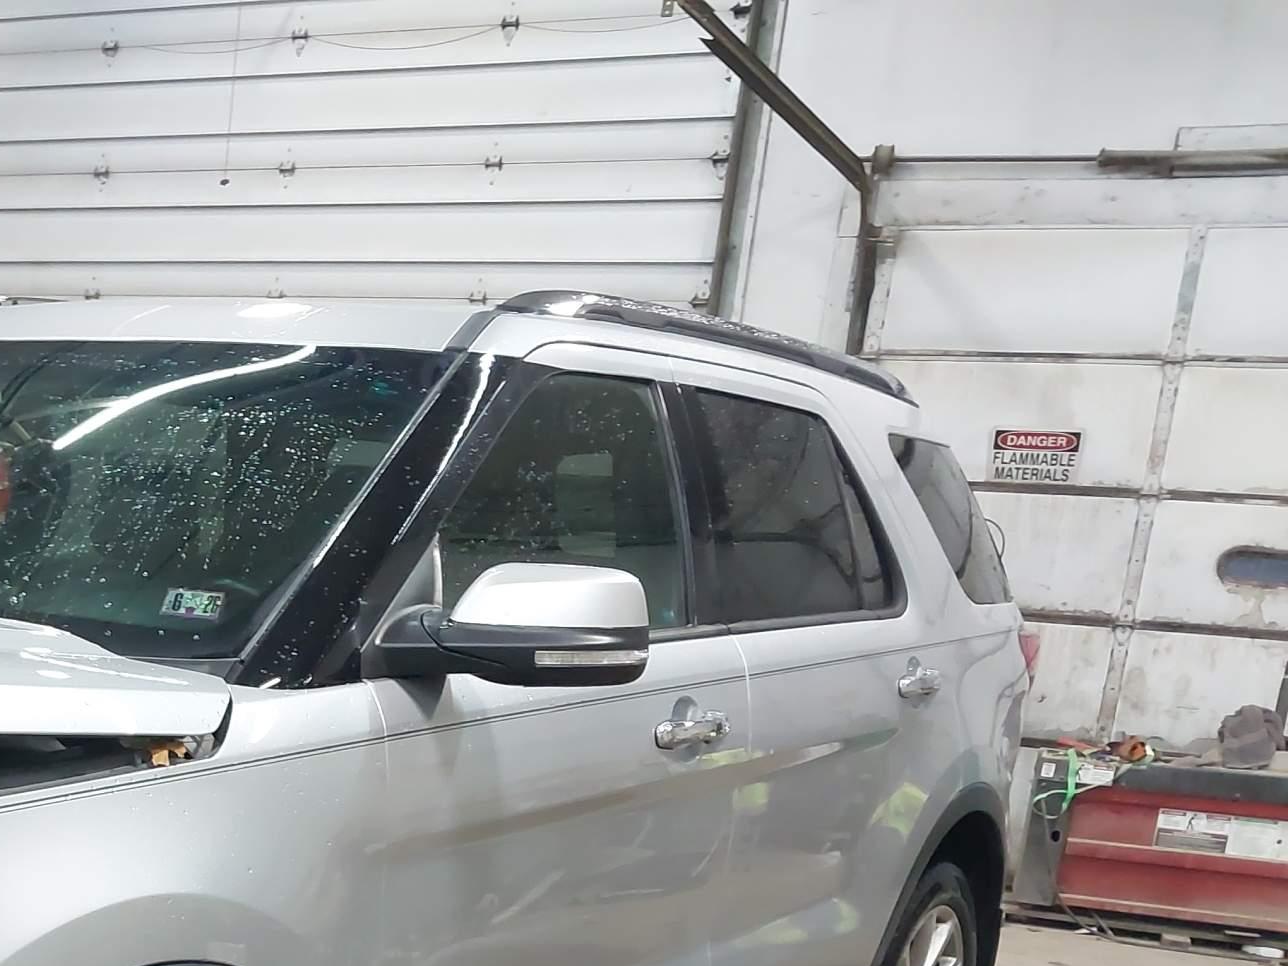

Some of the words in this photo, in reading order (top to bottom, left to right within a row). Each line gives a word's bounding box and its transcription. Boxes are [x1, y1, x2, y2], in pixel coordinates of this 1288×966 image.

[1006, 435, 1067, 447] DANGER
[993, 452, 1076, 467] FLAMMABLE
[994, 467, 1070, 482] MATERIALS
[172, 592, 184, 611] 6
